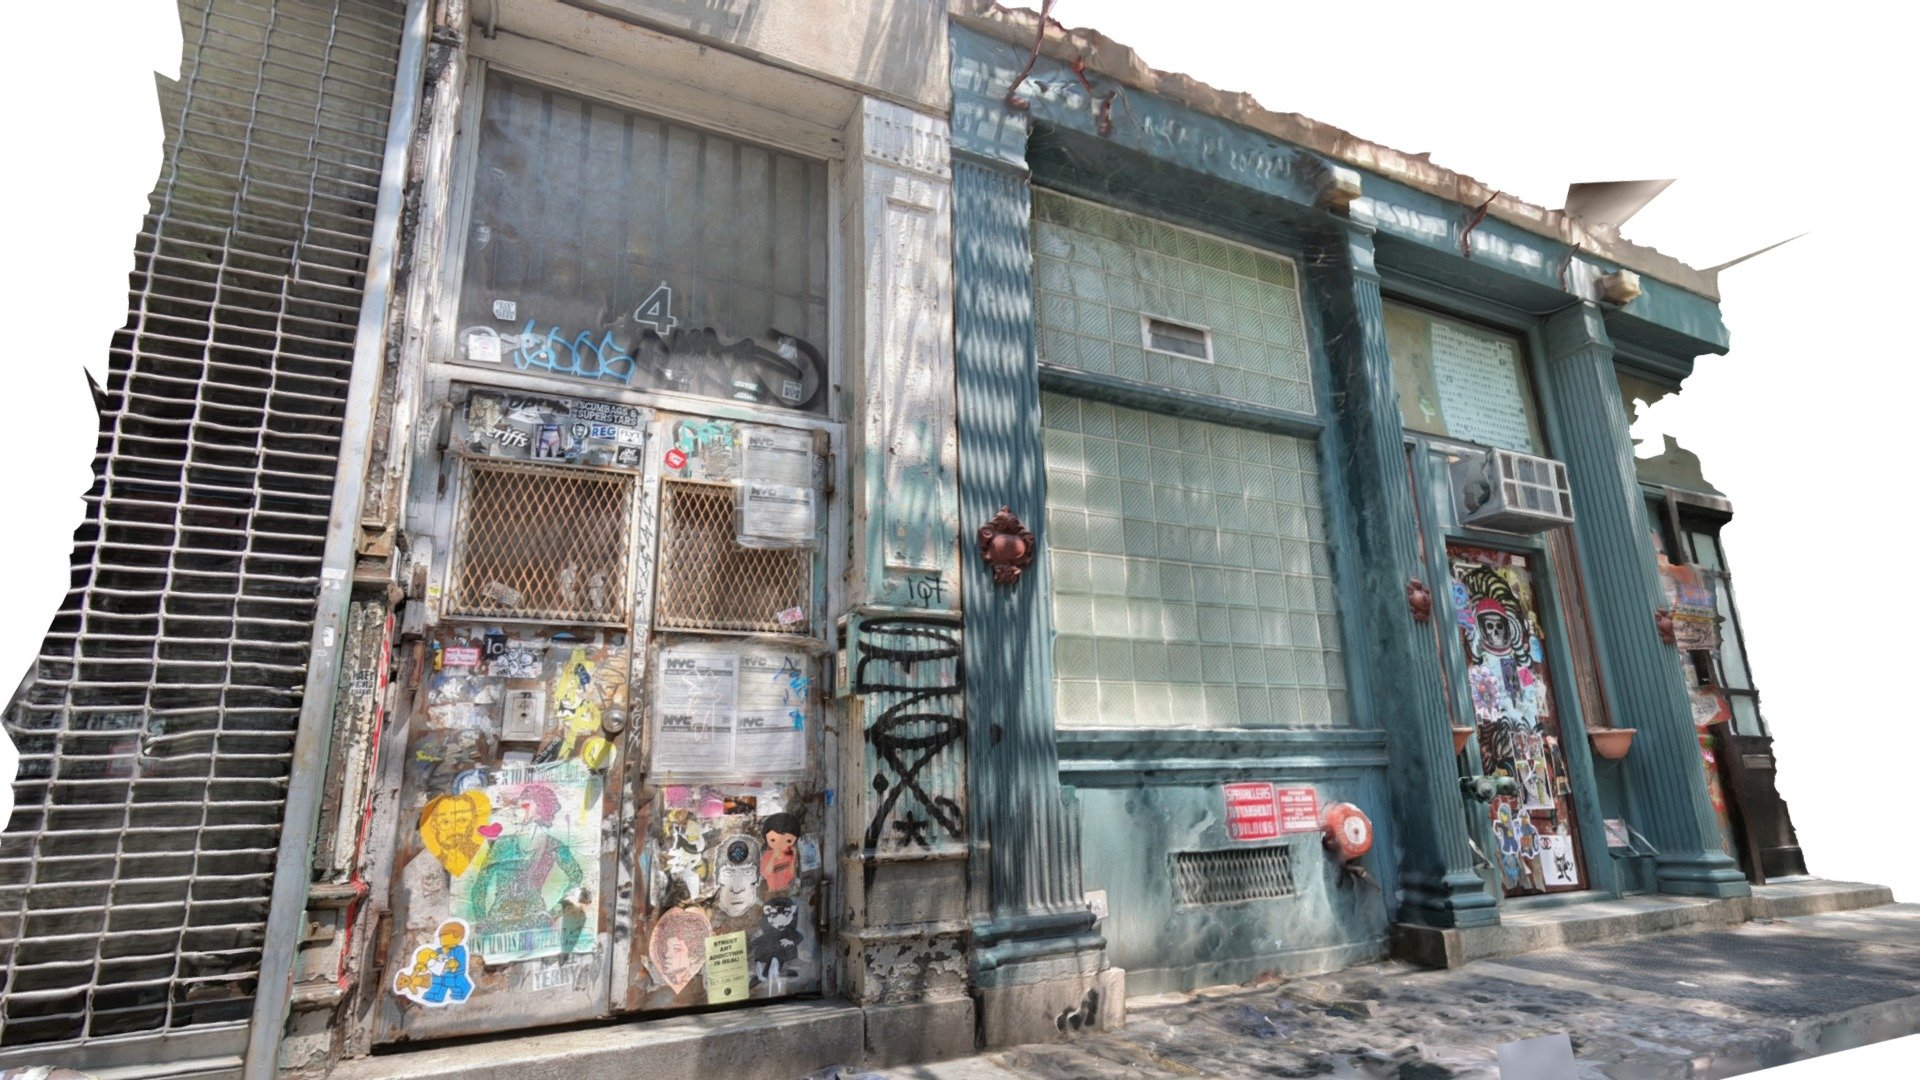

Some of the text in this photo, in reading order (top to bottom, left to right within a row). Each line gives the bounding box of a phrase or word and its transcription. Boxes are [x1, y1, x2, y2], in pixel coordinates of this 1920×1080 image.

[633, 281, 678, 335] 4
[579, 401, 629, 416] SCUMBAGS
[577, 410, 637, 425] SUPERSTARS
[592, 426, 616, 437] REG
[667, 658, 696, 668] NYC
[663, 715, 692, 726] NYC
[1225, 787, 1272, 800] SPRINKLERS
[1231, 821, 1275, 837] BUILDING
[713, 938, 738, 947] STREET
[709, 950, 744, 961] ADDICTION
